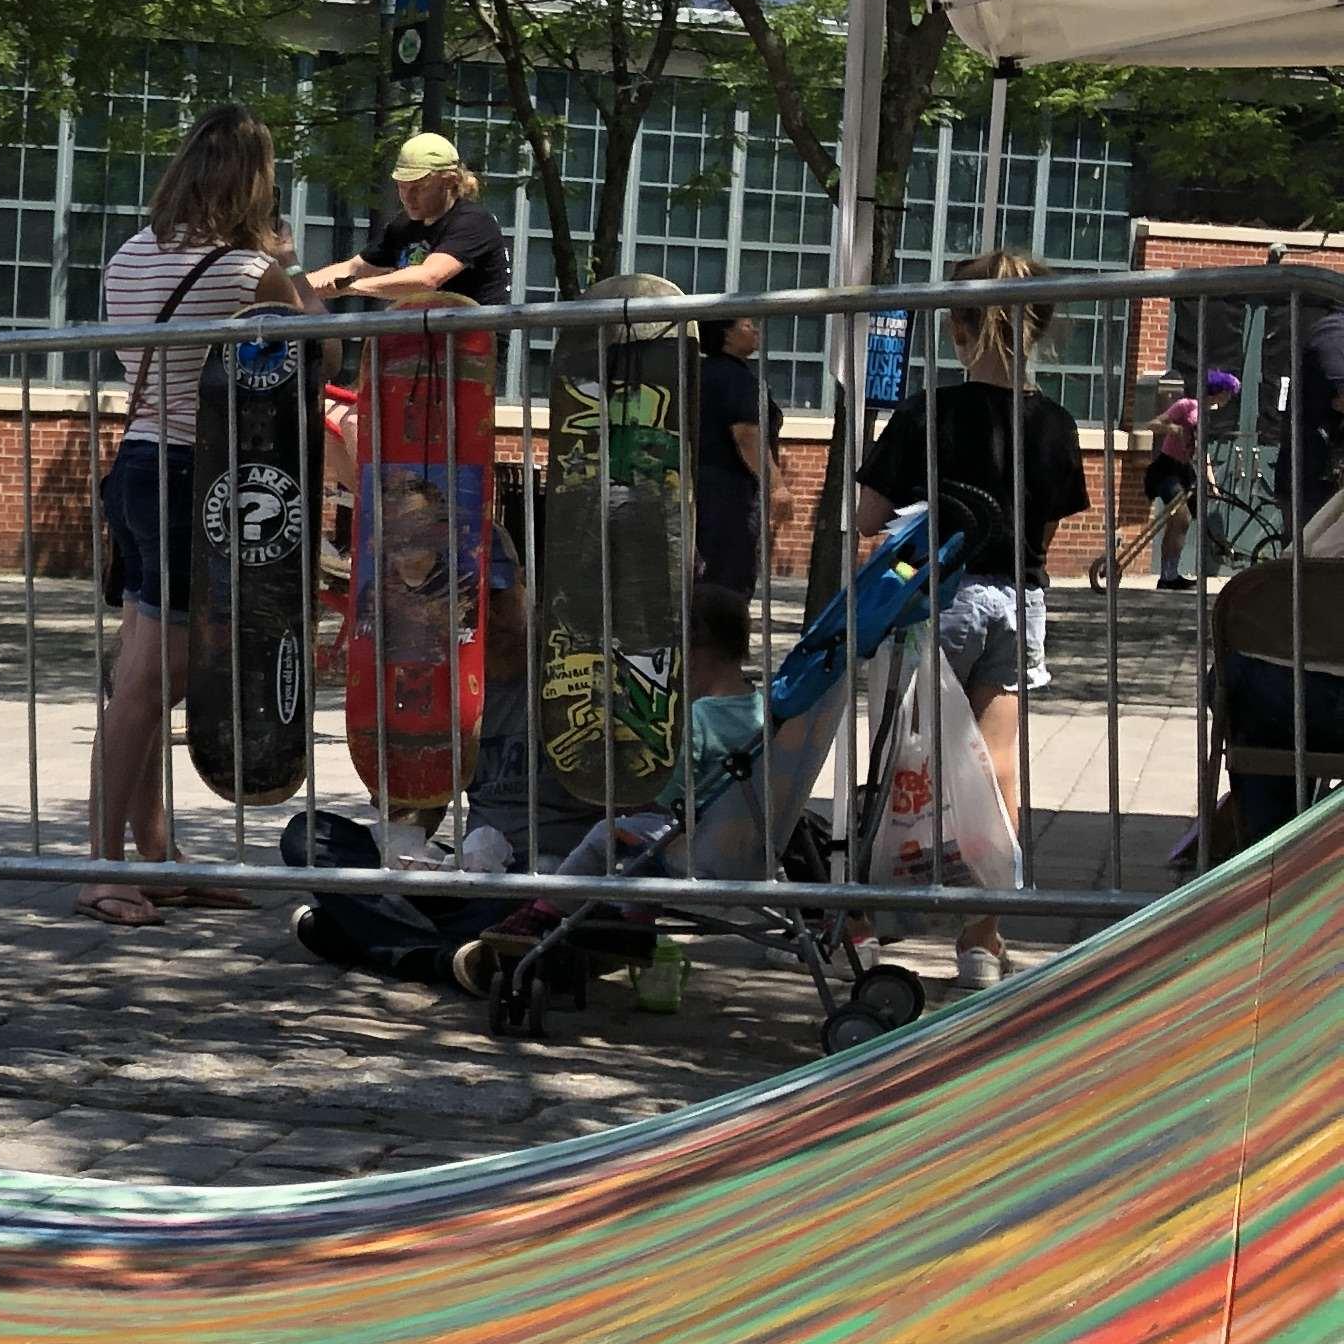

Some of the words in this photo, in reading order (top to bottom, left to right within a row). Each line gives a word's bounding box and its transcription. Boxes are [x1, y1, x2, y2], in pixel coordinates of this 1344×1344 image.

[868, 353, 903, 378] USIC
[865, 375, 902, 401] TAGE
[247, 466, 292, 496] ARE
